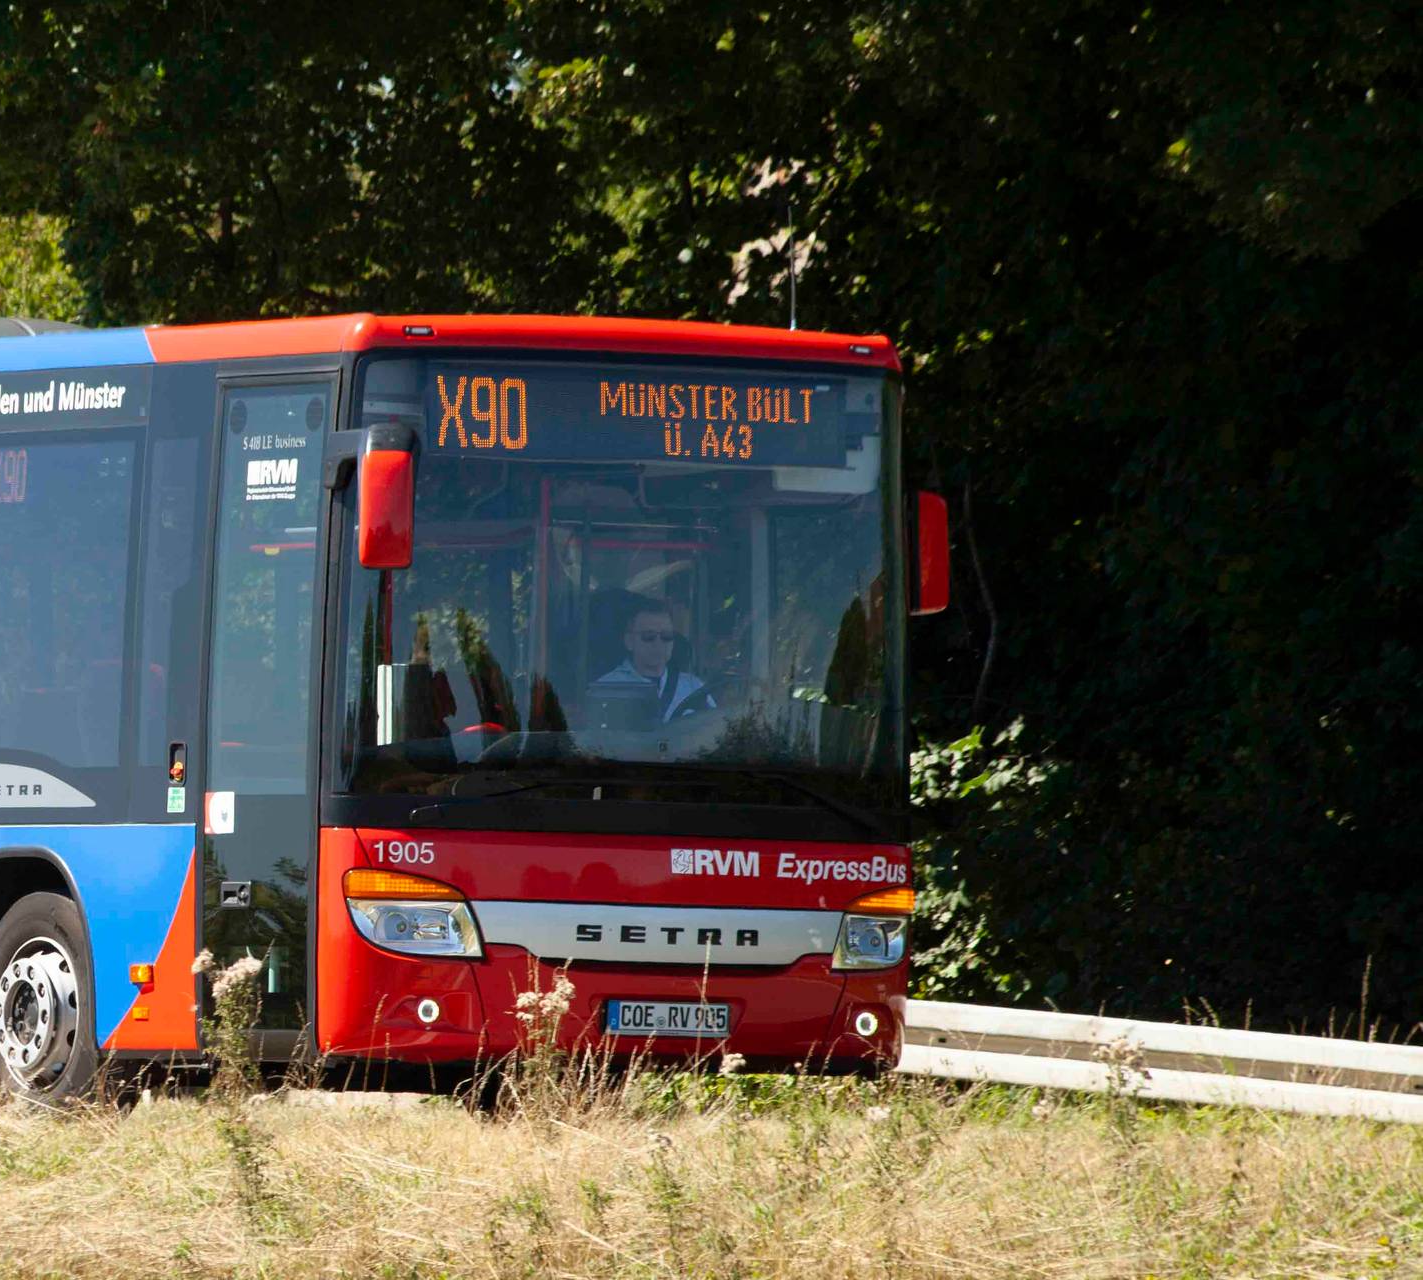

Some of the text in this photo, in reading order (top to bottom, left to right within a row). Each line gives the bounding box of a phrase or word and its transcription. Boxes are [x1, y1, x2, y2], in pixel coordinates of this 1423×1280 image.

[23, 380, 55, 412] und
[58, 381, 126, 411] Münster
[599, 381, 814, 424] MÜNSTER BÜLT
[436, 375, 527, 449] X90
[242, 436, 249, 451] S
[262, 434, 273, 449] LE
[274, 433, 307, 449] business
[663, 422, 753, 459] Ü. A43
[260, 458, 298, 485] RVM
[373, 841, 434, 864] 1905
[695, 849, 907, 885] RVM ExpressBus
[576, 924, 759, 946] SETRA
[621, 1004, 655, 1027] COE
[668, 1006, 690, 1028] RV
